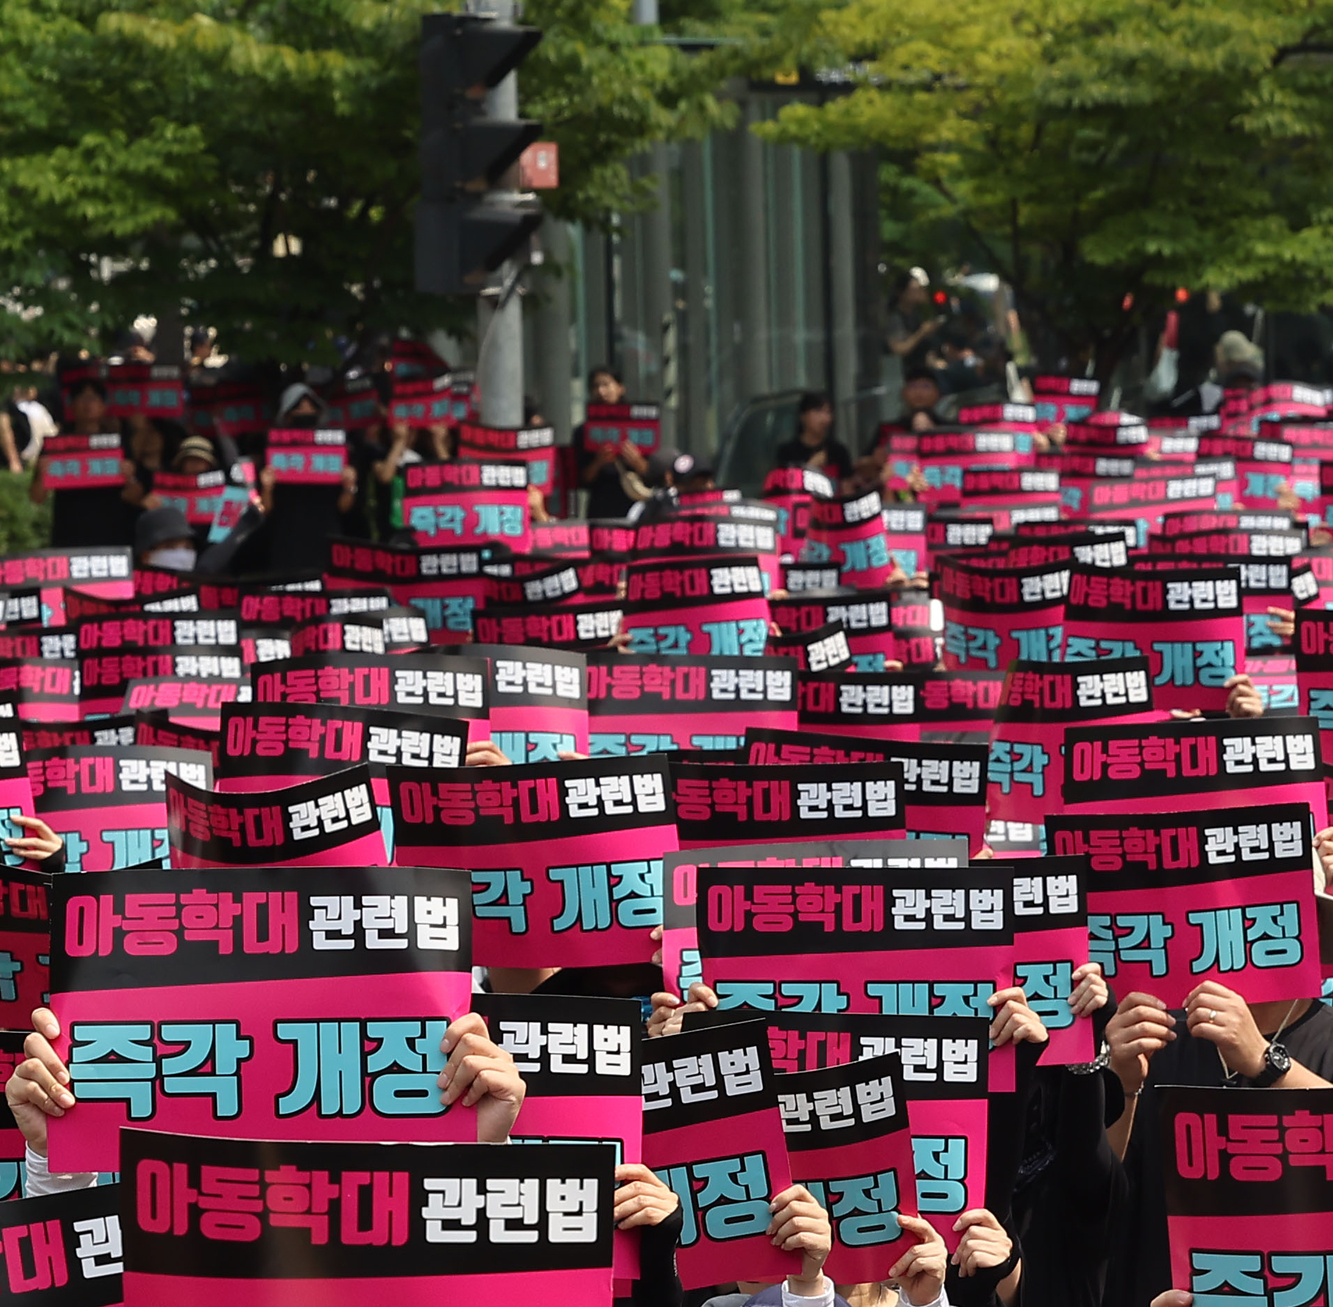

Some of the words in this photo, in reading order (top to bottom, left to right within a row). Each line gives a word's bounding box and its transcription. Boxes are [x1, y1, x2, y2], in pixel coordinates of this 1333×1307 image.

[708, 565, 764, 597] 관련법
[1070, 574, 1164, 612] 아동학대
[1165, 578, 1239, 612] 관련법
[79, 618, 173, 650] 아동학대
[173, 619, 239, 646] 관련법
[495, 659, 582, 700] 관련법
[710, 667, 794, 703] 관련법
[1153, 640, 1238, 688] 개정
[394, 669, 484, 709] 관련법
[839, 683, 916, 715] 관련법
[1076, 670, 1149, 707] 관련법
[226, 716, 364, 762] 아동학대
[366, 725, 463, 768] 관련법
[1071, 735, 1218, 782] 아동학대
[1222, 733, 1315, 775] 관련법
[288, 783, 374, 841] 관련법
[400, 777, 559, 826] 아동학대
[564, 773, 667, 819] 관련법
[796, 780, 897, 819] 관련법
[1204, 821, 1304, 866] 관련법
[547, 858, 664, 936] 개정
[707, 882, 884, 934] 아동학대
[890, 887, 1005, 932] 관련법
[64, 889, 299, 957] 아동학대
[308, 895, 460, 951] 관련법
[1187, 901, 1303, 975] 개정
[68, 1020, 254, 1121] 즉각
[274, 1018, 451, 1119] 개정
[500, 1018, 632, 1077] 관련법
[136, 1159, 409, 1246] 아동학대
[421, 1177, 599, 1244] 관련법
